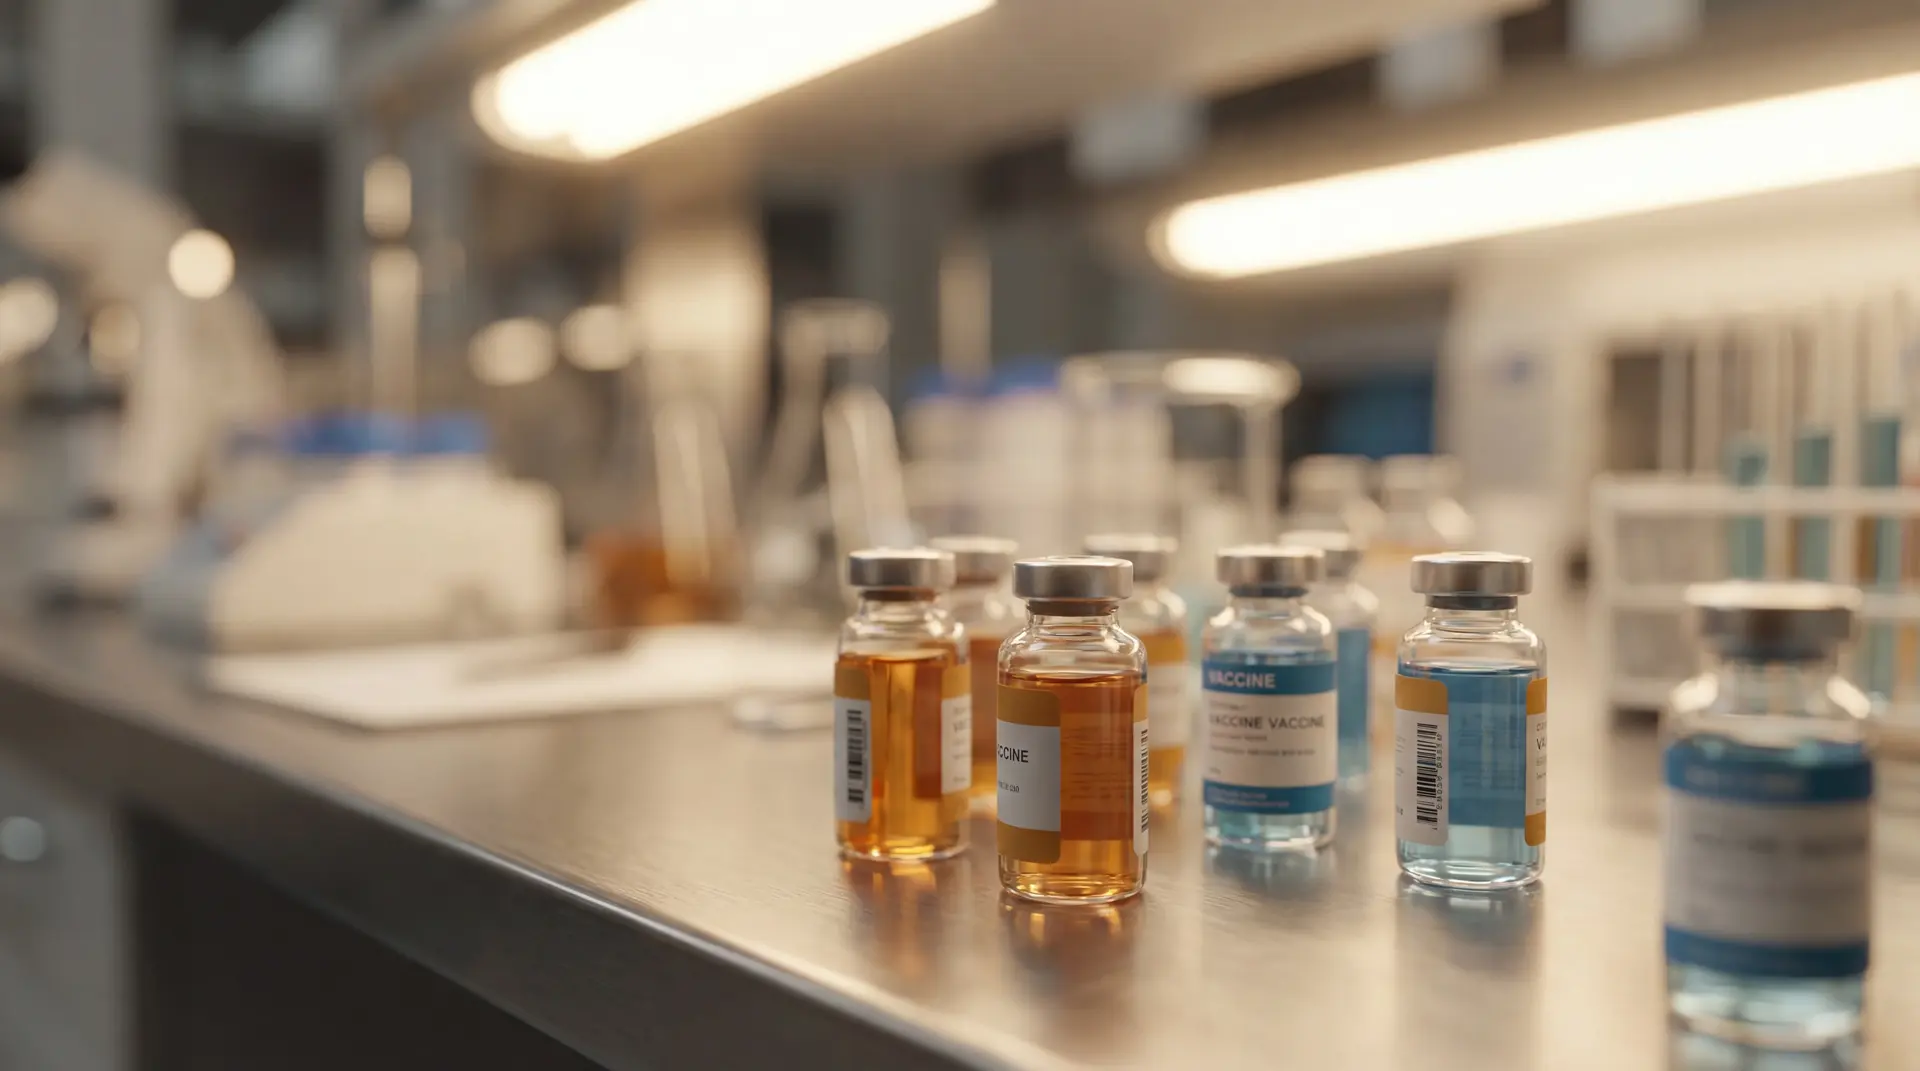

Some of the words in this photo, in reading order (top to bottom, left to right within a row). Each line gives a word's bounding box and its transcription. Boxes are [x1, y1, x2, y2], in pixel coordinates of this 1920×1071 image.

[1208, 671, 1277, 689] VACCINE
[1268, 714, 1325, 730] VACCINE
[998, 744, 1029, 763] CCINE
